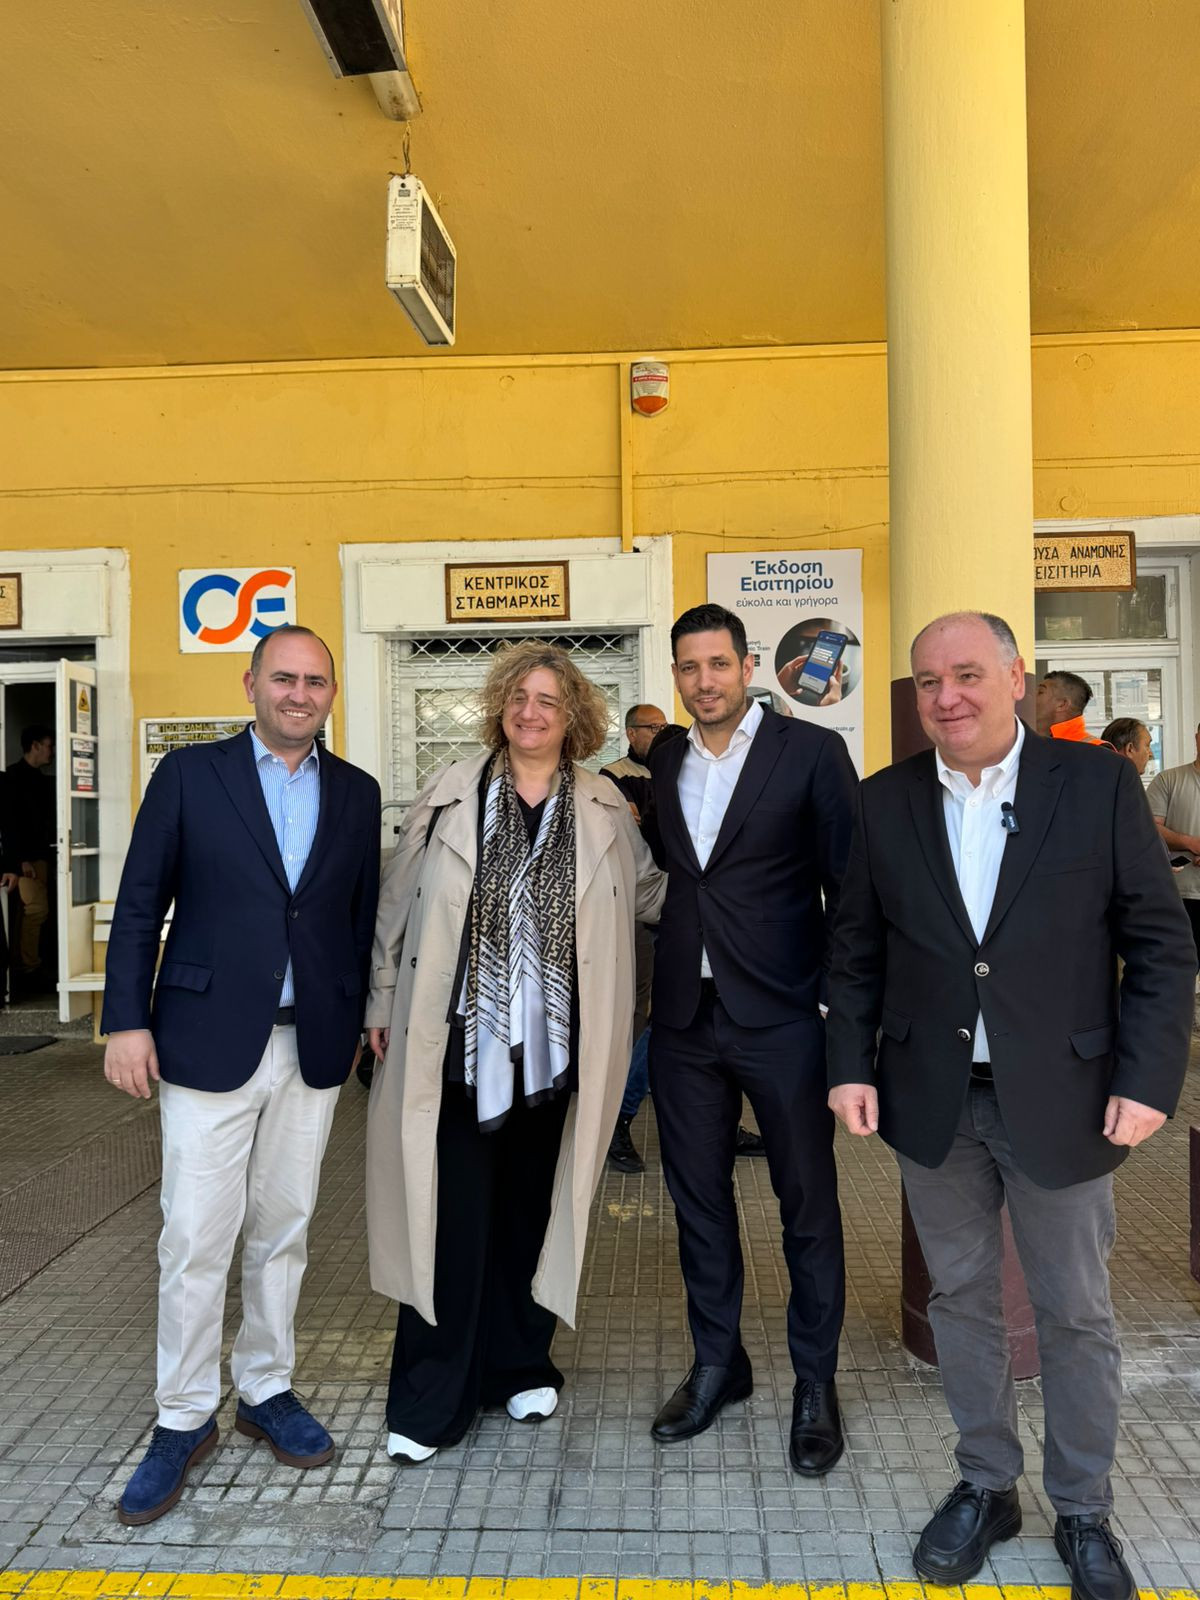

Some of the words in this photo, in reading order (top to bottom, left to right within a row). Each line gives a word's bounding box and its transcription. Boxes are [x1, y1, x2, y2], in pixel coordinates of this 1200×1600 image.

[1070, 544, 1126, 559] ΑΝΑΜΟΝΗΣ
[751, 559, 823, 576] Έκδοση
[1035, 564, 1102, 580] ΕΙΣΙΤΗΡΙΑ
[464, 575, 550, 591] ΚΕΝΤΡΙΚΟΣ
[740, 574, 834, 594] Εισιτηρίου
[455, 594, 561, 610] ΣΤΑΘΜΑΡΧΗΣ
[736, 597, 773, 608] εύκολα
[775, 599, 792, 607] και
[794, 595, 839, 609] γρήγορα
